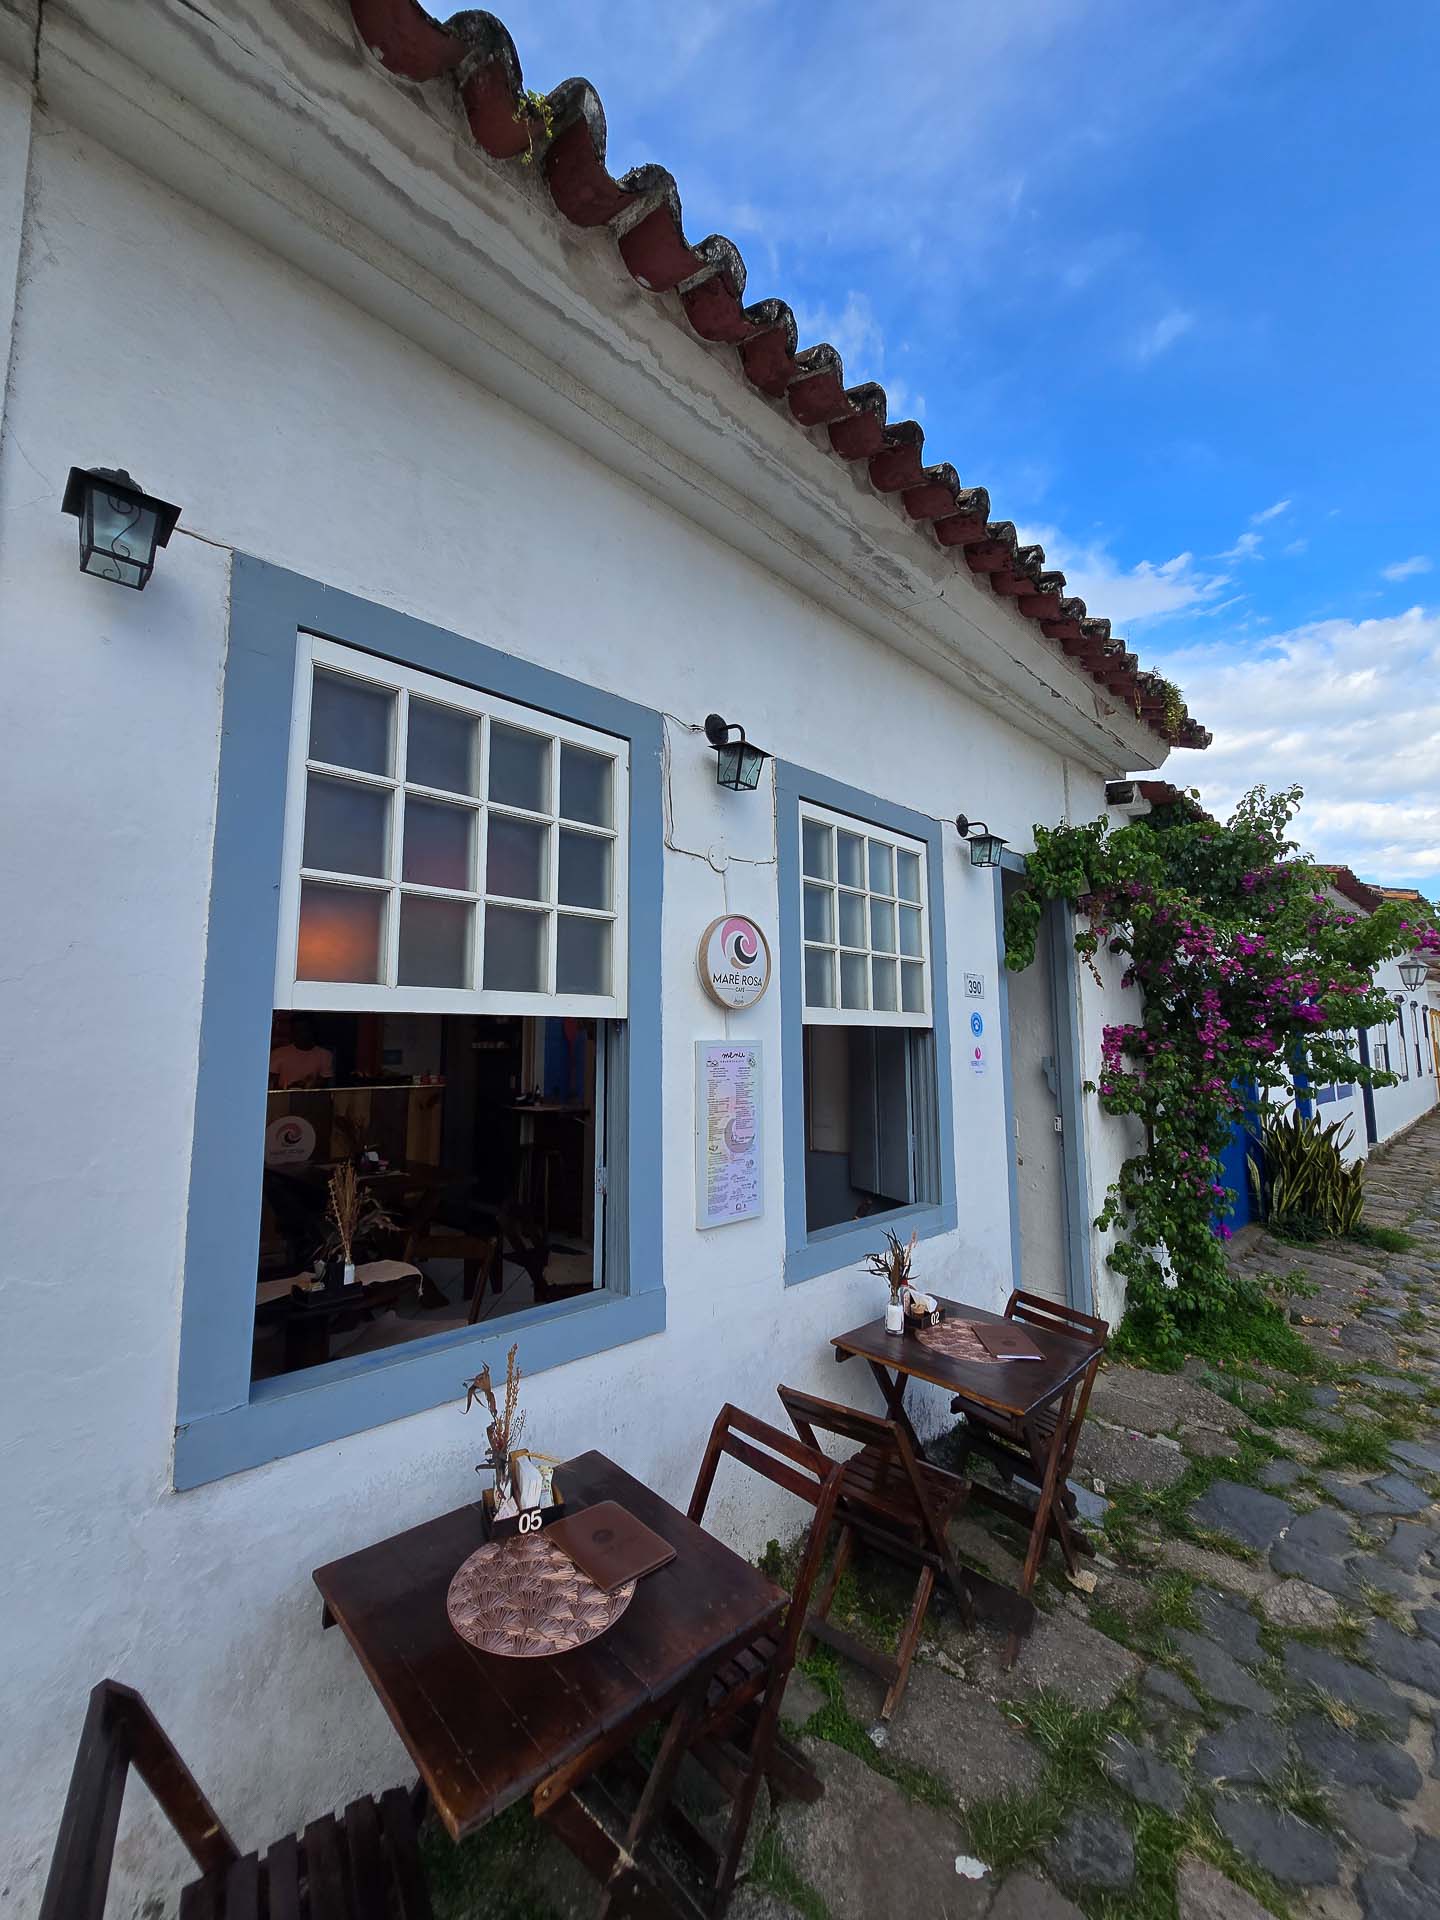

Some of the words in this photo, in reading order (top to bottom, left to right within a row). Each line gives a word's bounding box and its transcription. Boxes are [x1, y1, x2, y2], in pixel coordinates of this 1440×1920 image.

[713, 972, 740, 985] MARÉ
[742, 975, 762, 987] ROSA
[968, 980, 982, 994] 390
[721, 1051, 745, 1059] menu
[930, 1311, 940, 1326] 02
[518, 1509, 543, 1534] 05
